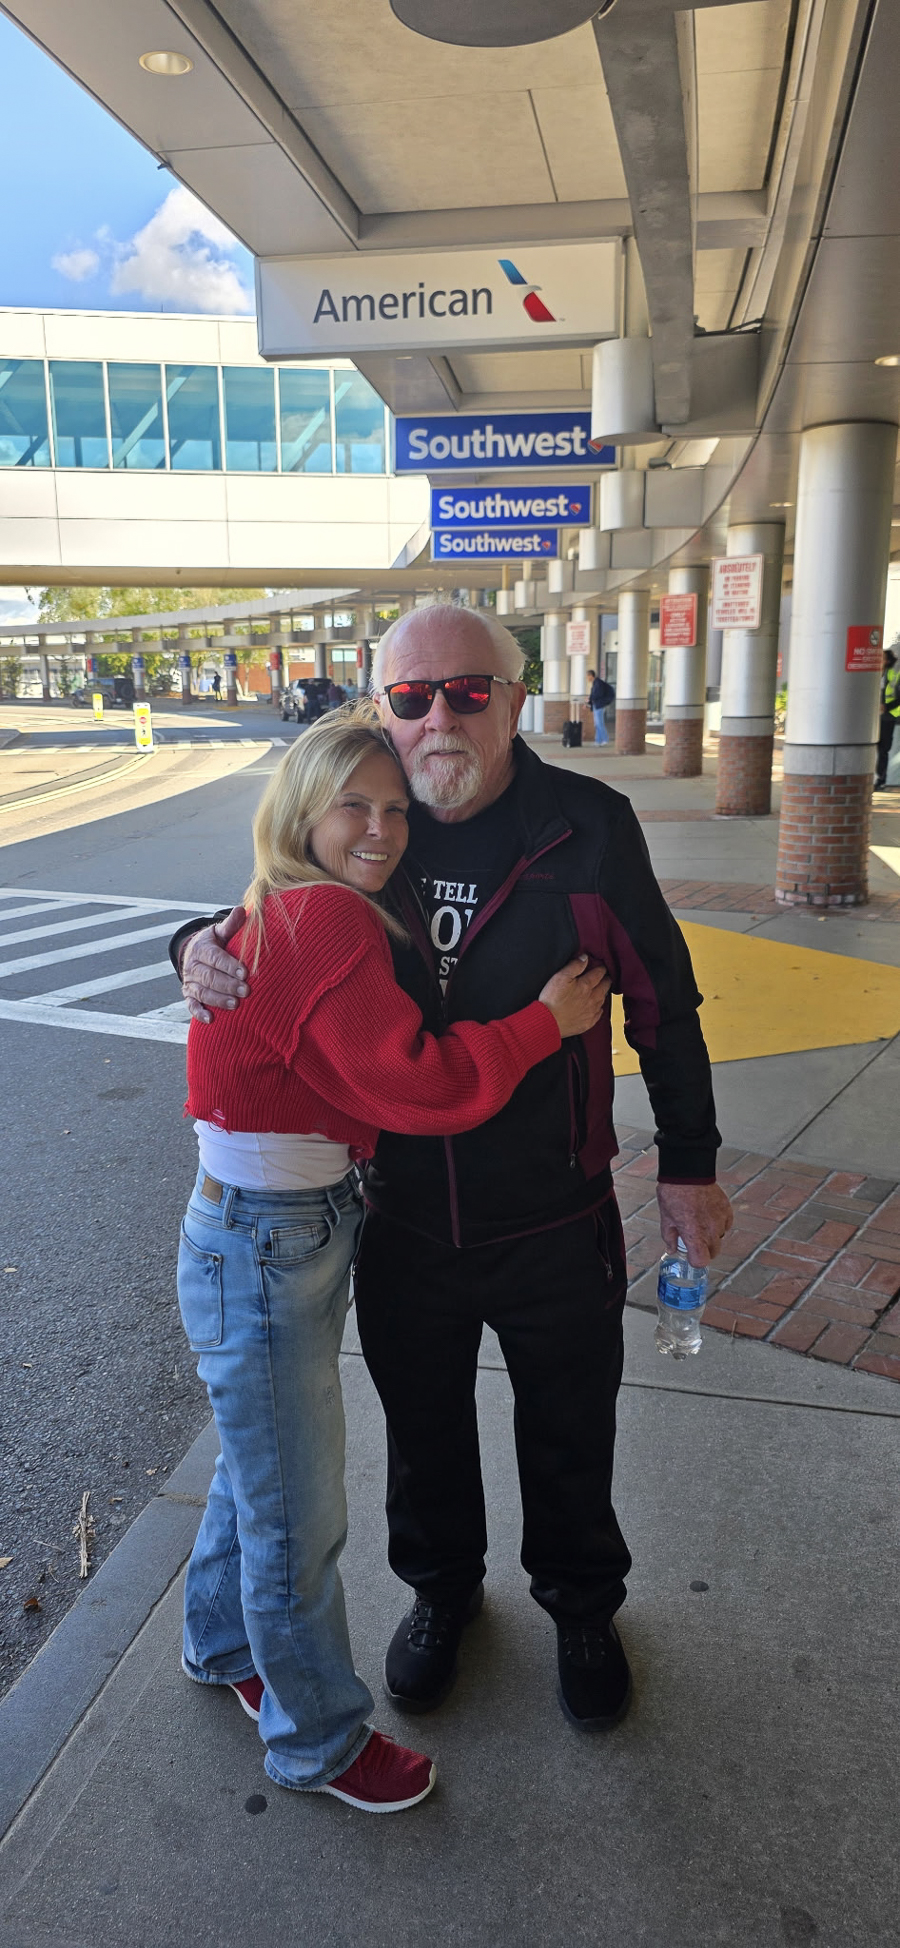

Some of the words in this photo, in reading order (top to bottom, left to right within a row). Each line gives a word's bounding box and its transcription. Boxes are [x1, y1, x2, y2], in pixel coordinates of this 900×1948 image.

[313, 282, 493, 324] American
[408, 425, 587, 460] Southwest
[438, 493, 569, 520] Southwest
[439, 533, 541, 554] Southwest
[433, 879, 479, 905] TELL
